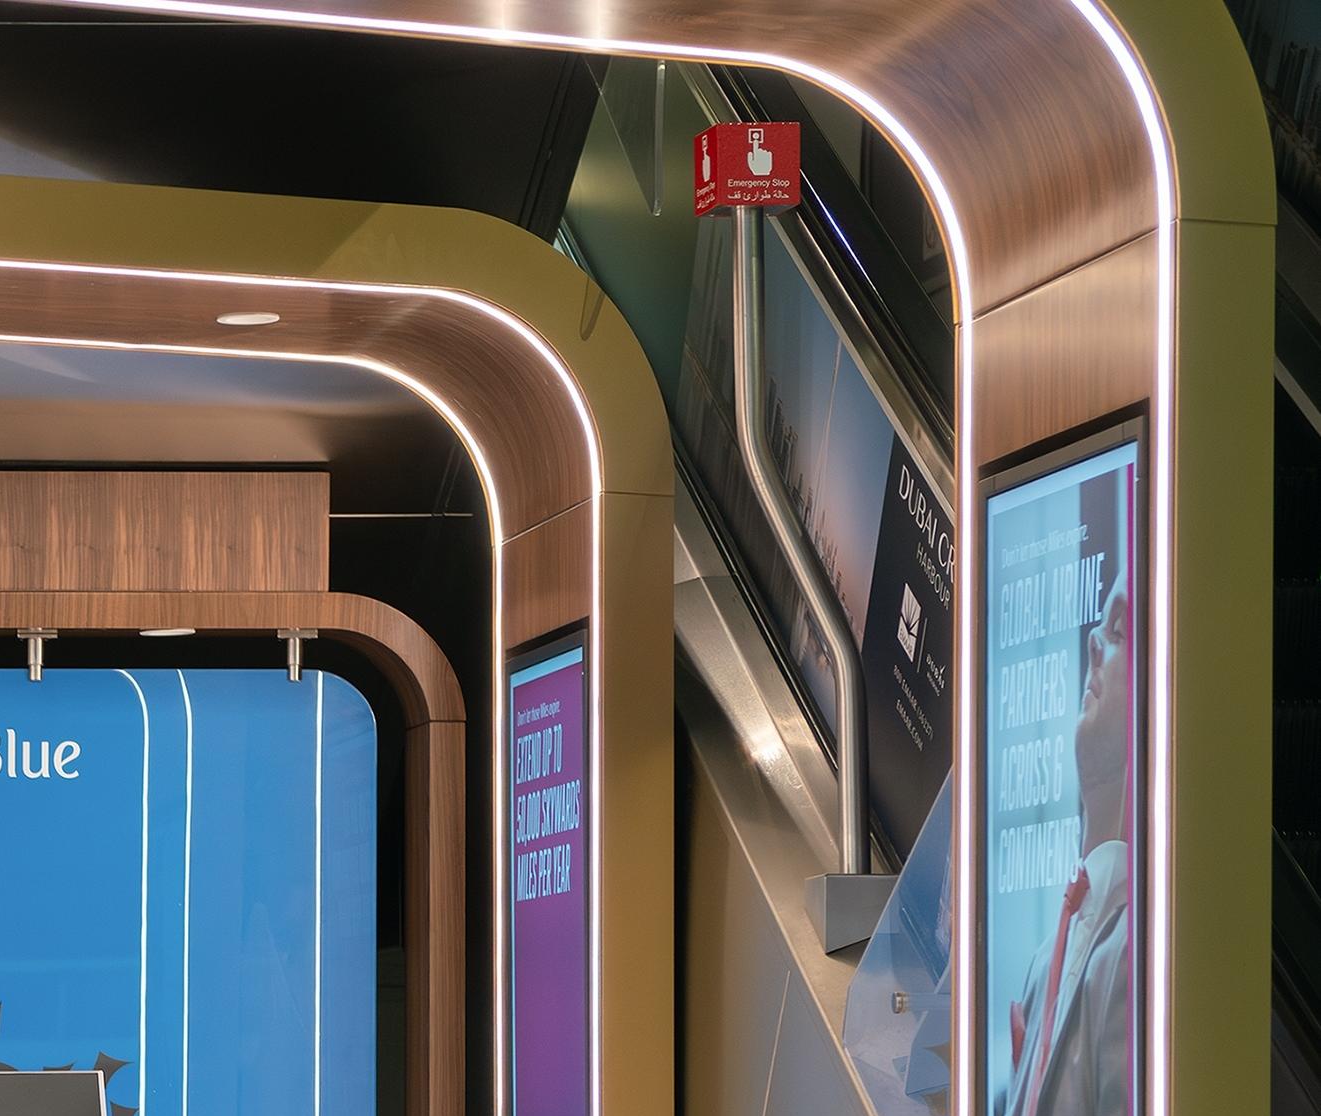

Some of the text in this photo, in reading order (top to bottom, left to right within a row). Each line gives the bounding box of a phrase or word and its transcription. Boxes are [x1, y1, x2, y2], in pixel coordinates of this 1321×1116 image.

[727, 178, 790, 188] Emergency Stop
[898, 464, 938, 549] DUBAI
[916, 541, 950, 611] HARBOUR
[1000, 552, 1105, 650] GLOBAL AIRLINE
[999, 649, 1068, 731] PARTNERS
[516, 723, 562, 784] EXTEND UP TO
[998, 734, 1064, 813] ACROSS 6
[541, 779, 581, 837] SKYWARDS
[516, 843, 571, 902] MILES PER YEAR
[998, 814, 1081, 894] CONTINENTS
